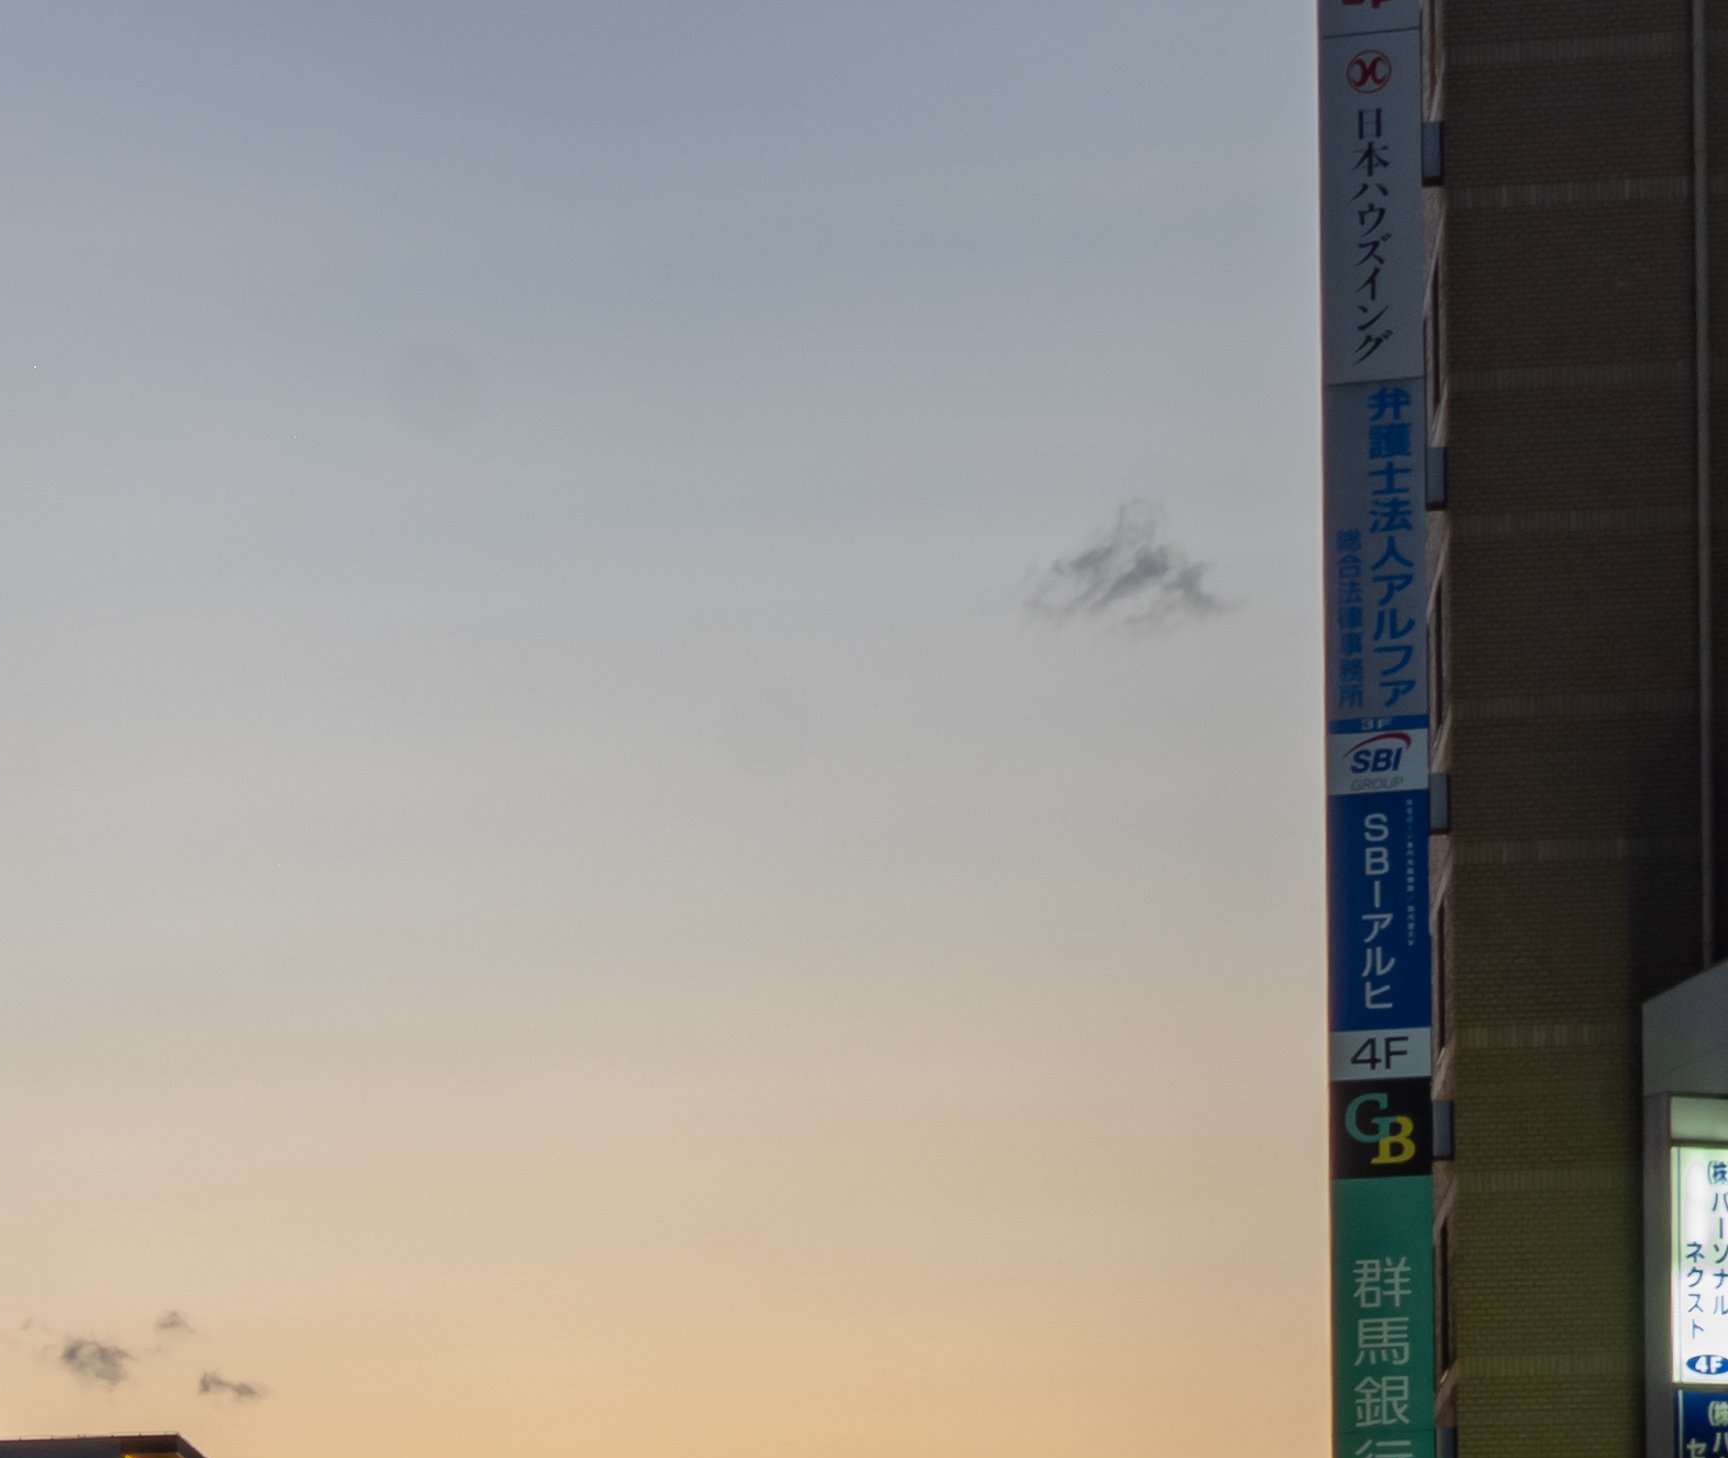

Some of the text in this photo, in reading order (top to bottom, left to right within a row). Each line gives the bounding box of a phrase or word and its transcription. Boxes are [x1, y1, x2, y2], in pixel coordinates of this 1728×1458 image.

[1350, 107, 1394, 366] 日本ハウズイング
[1367, 386, 1417, 707] 弁護士法人アルファ
[1350, 747, 1403, 774] SBI
[1350, 776, 1404, 791] GROUP
[1350, 1035, 1410, 1071] 4F
[1686, 1242, 1705, 1340] ネクスト
[1693, 1355, 1726, 1374] 4F
